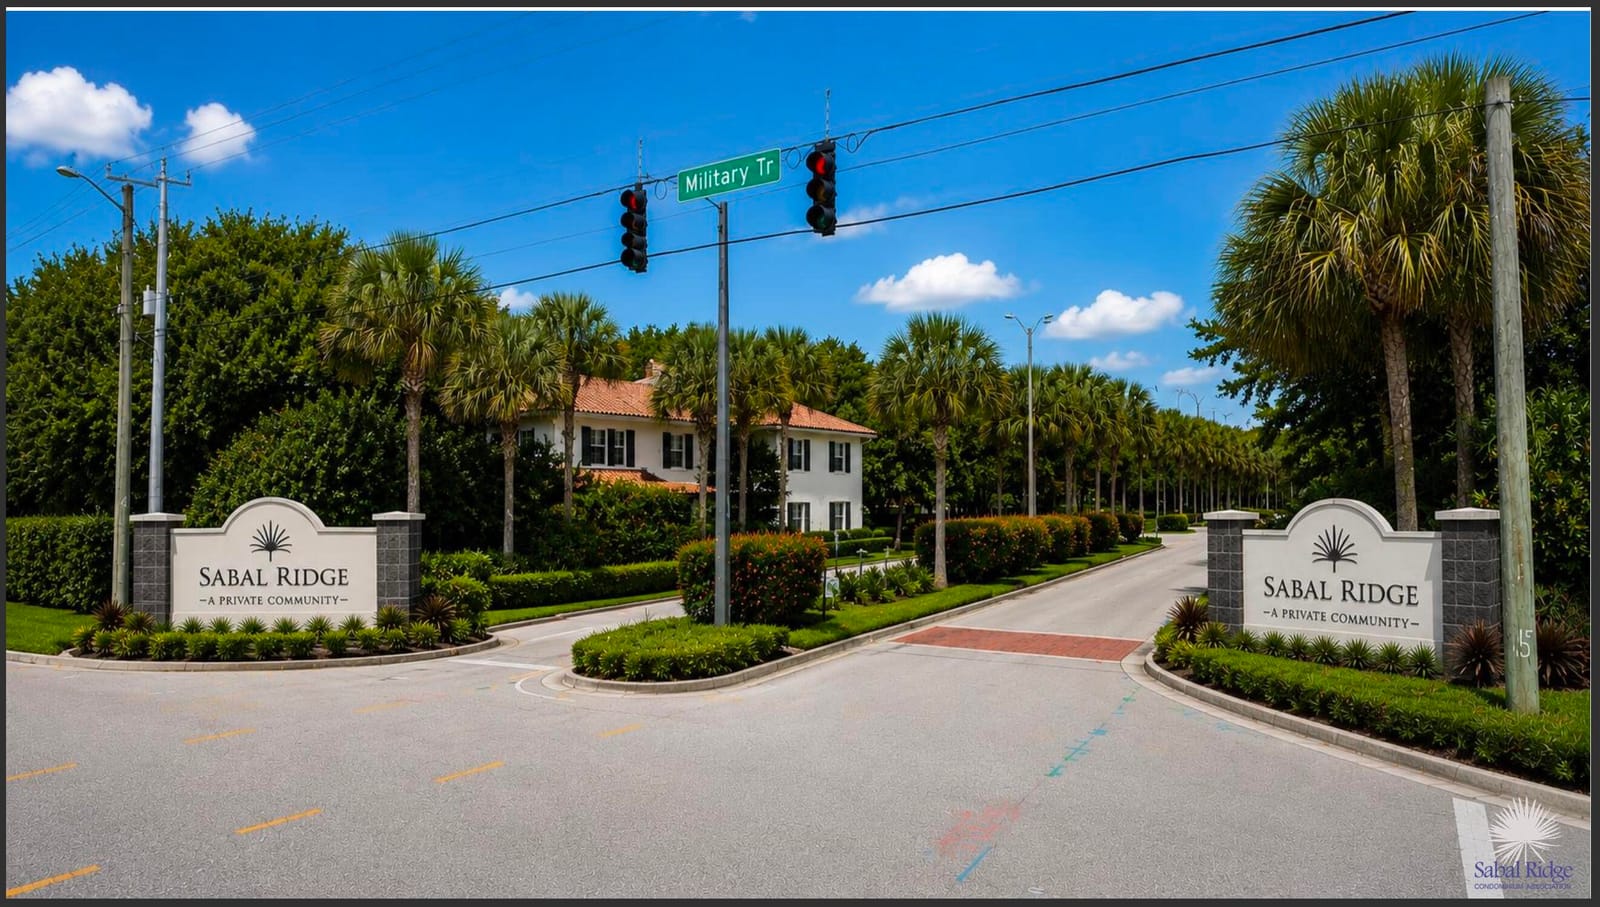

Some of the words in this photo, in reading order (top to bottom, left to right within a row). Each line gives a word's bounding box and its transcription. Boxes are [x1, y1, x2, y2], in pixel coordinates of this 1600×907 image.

[685, 166, 749, 193] Military
[756, 157, 774, 176] Tr
[199, 566, 268, 587] SABAL
[276, 566, 349, 587] RIDGE
[219, 596, 264, 606] PRIVATE
[1264, 575, 1332, 601] SABAL
[1341, 579, 1419, 606] RIDGE
[1281, 608, 1327, 622] PRIVATE
